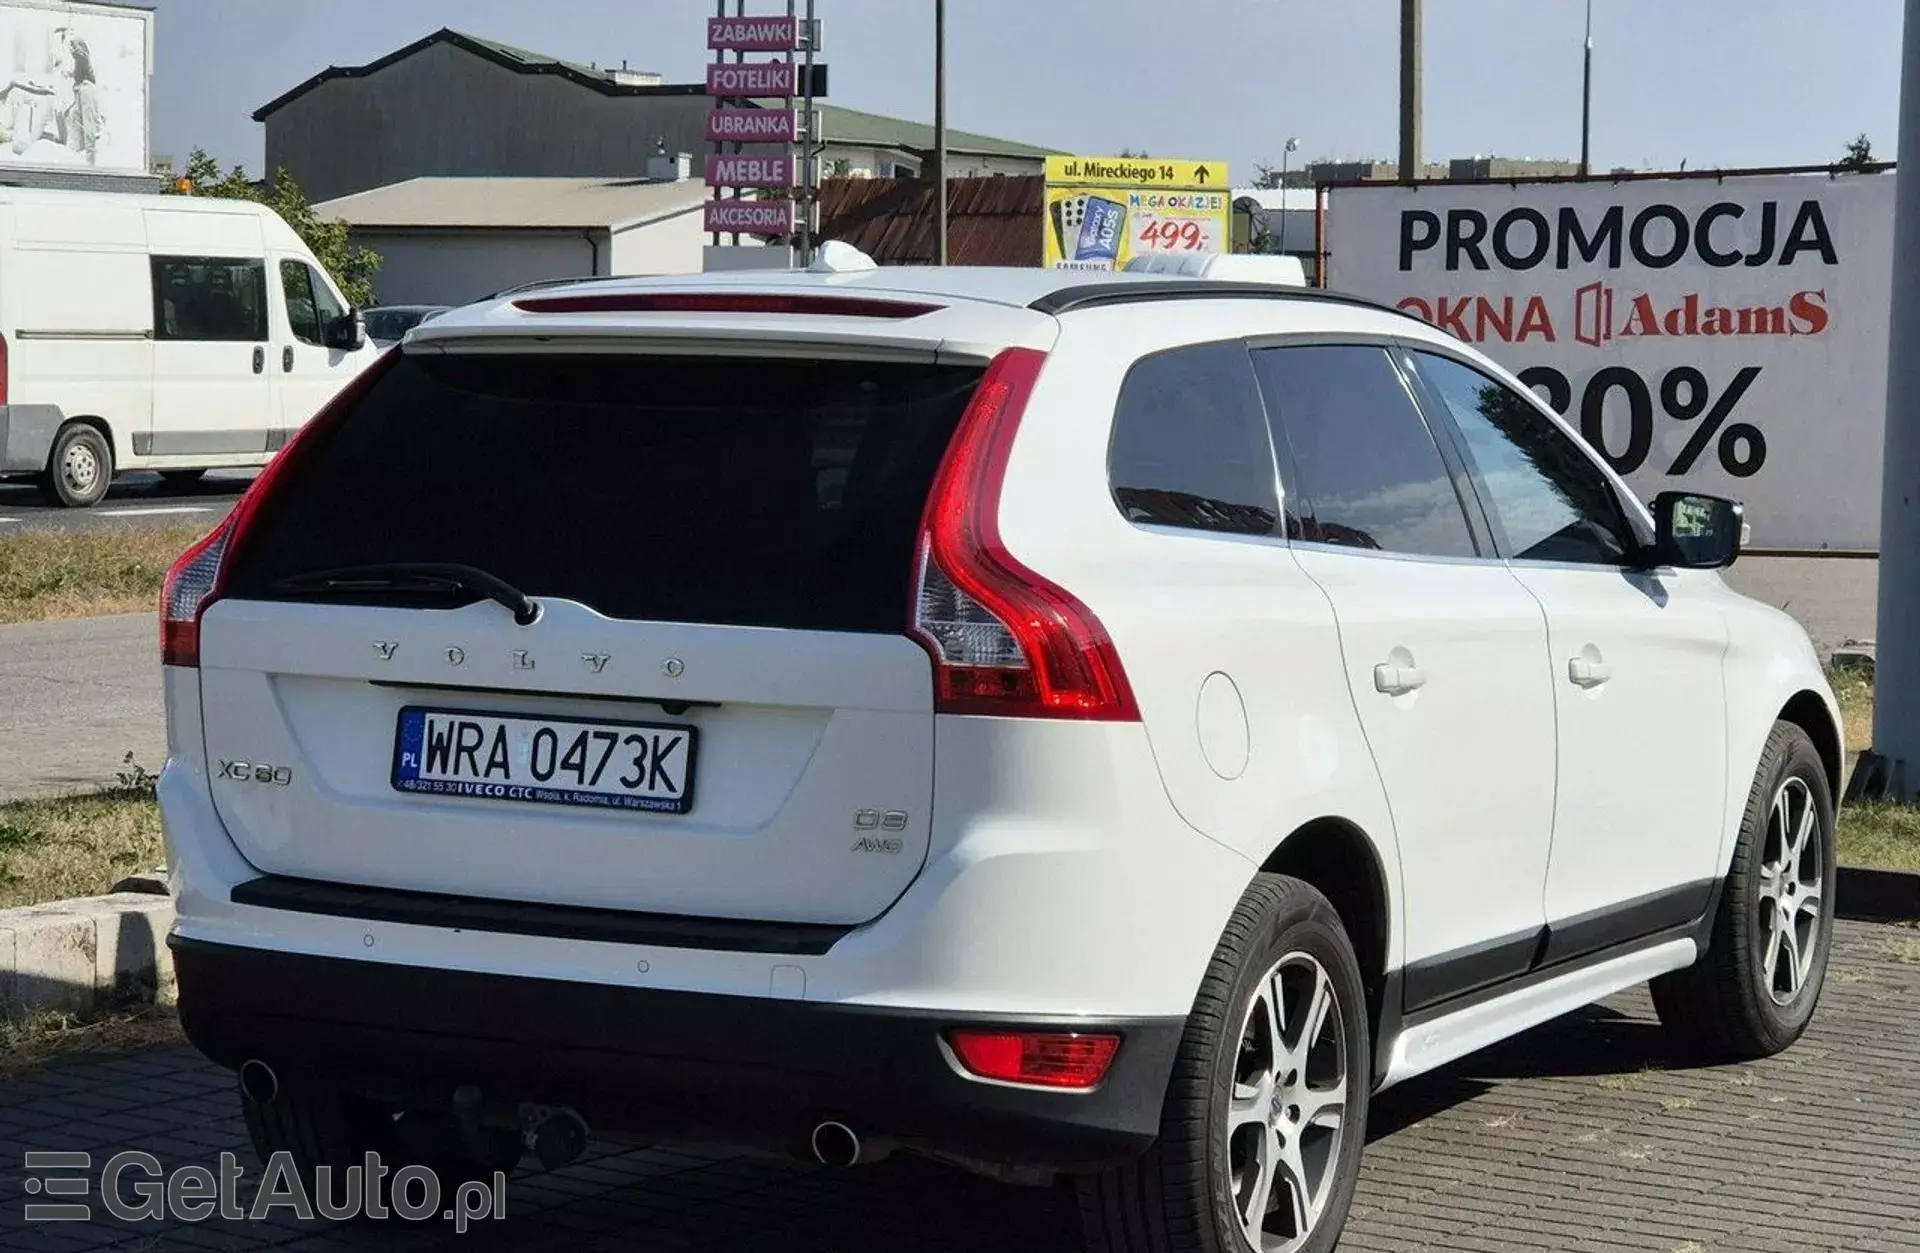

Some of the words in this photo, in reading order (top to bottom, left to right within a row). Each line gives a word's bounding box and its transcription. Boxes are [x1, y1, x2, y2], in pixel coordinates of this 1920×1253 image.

[712, 24, 792, 42] ZABAWKI
[713, 70, 790, 89] FOTELIKI
[711, 116, 789, 134] UBRANKA
[715, 160, 784, 182] MEBLE
[1064, 162, 1081, 177] ul.
[1084, 162, 1155, 183] Mireckiego
[1159, 165, 1174, 180] 14
[708, 207, 788, 225] AKCESORIA
[1399, 200, 1838, 271] PROMOCJA
[1620, 288, 1829, 337] AdamS
[372, 640, 685, 678] VOLVO
[401, 752, 418, 768] PL
[425, 719, 511, 780] WRA
[530, 727, 683, 793] 0473K
[457, 783, 505, 797] IVECO
